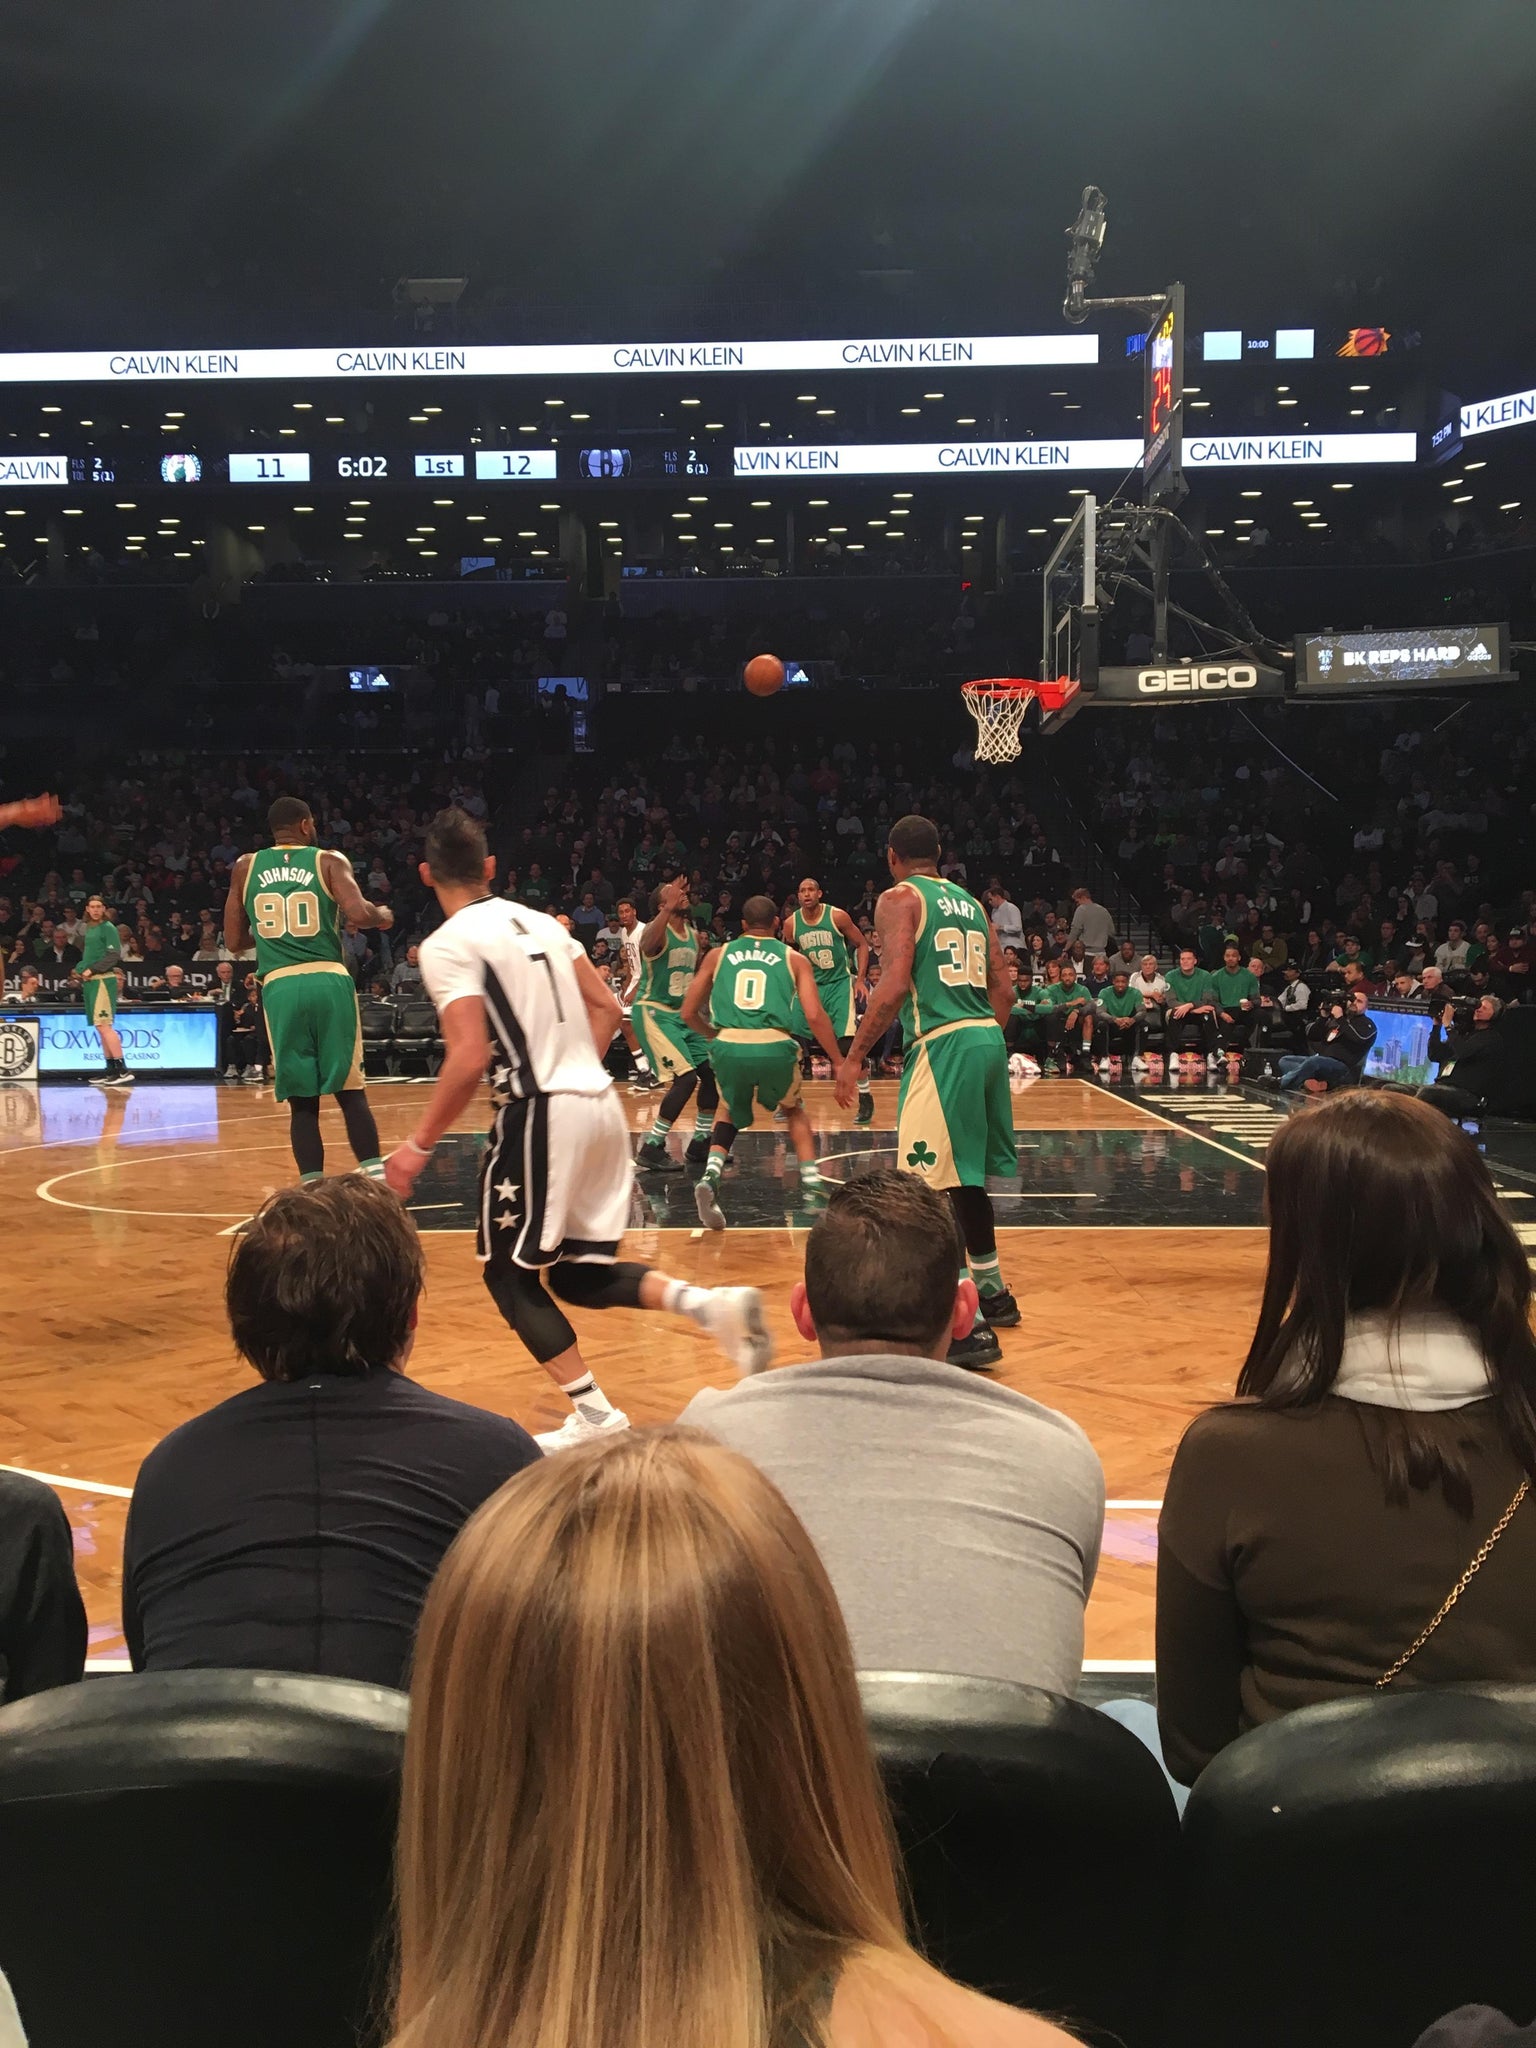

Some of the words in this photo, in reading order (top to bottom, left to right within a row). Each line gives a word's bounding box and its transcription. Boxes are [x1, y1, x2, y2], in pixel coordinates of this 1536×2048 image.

[842, 344, 913, 363] CALVIN
[919, 343, 972, 361] KLEIN
[1247, 340, 1269, 349] 10:00
[109, 356, 180, 374] CALVIN
[185, 355, 238, 373] KLEIN
[336, 353, 407, 371] CALVIN
[412, 352, 465, 370] KLEIN
[613, 348, 684, 367] CALVIN
[690, 347, 743, 365] KLEIN
[1477, 396, 1534, 428] KLEIN
[664, 452, 678, 461] FLS
[689, 450, 697, 461] 2
[785, 451, 838, 469] KLEIN
[938, 448, 1009, 467] CALVIN
[1016, 446, 1069, 464] KLEIN
[1190, 442, 1262, 461] CALVIN
[1268, 440, 1322, 459] KLEIN
[94, 458, 102, 469] 2
[257, 459, 285, 478] 11
[338, 457, 387, 477] 6:02
[425, 458, 453, 474] 1st
[503, 456, 531, 475] 12
[686, 464, 709, 475] 6(1)
[92, 471, 115, 482] 5(1)
[1343, 651, 1366, 666] BK
[1368, 649, 1411, 665] REPS
[1413, 646, 1460, 662] HARD
[1466, 653, 1492, 662] adidas
[1138, 665, 1257, 693] GEICO
[257, 866, 314, 888] JOHNSON
[253, 890, 320, 939] 90
[936, 896, 976, 921] SMART
[726, 949, 783, 966] BRADLEY
[934, 927, 987, 989] 36
[528, 951, 567, 1024] 7
[734, 969, 767, 1011] 0
[39, 1027, 162, 1050] FOXWODS
[4, 1038, 16, 1064] B
[125, 1052, 161, 1061] CASINO
